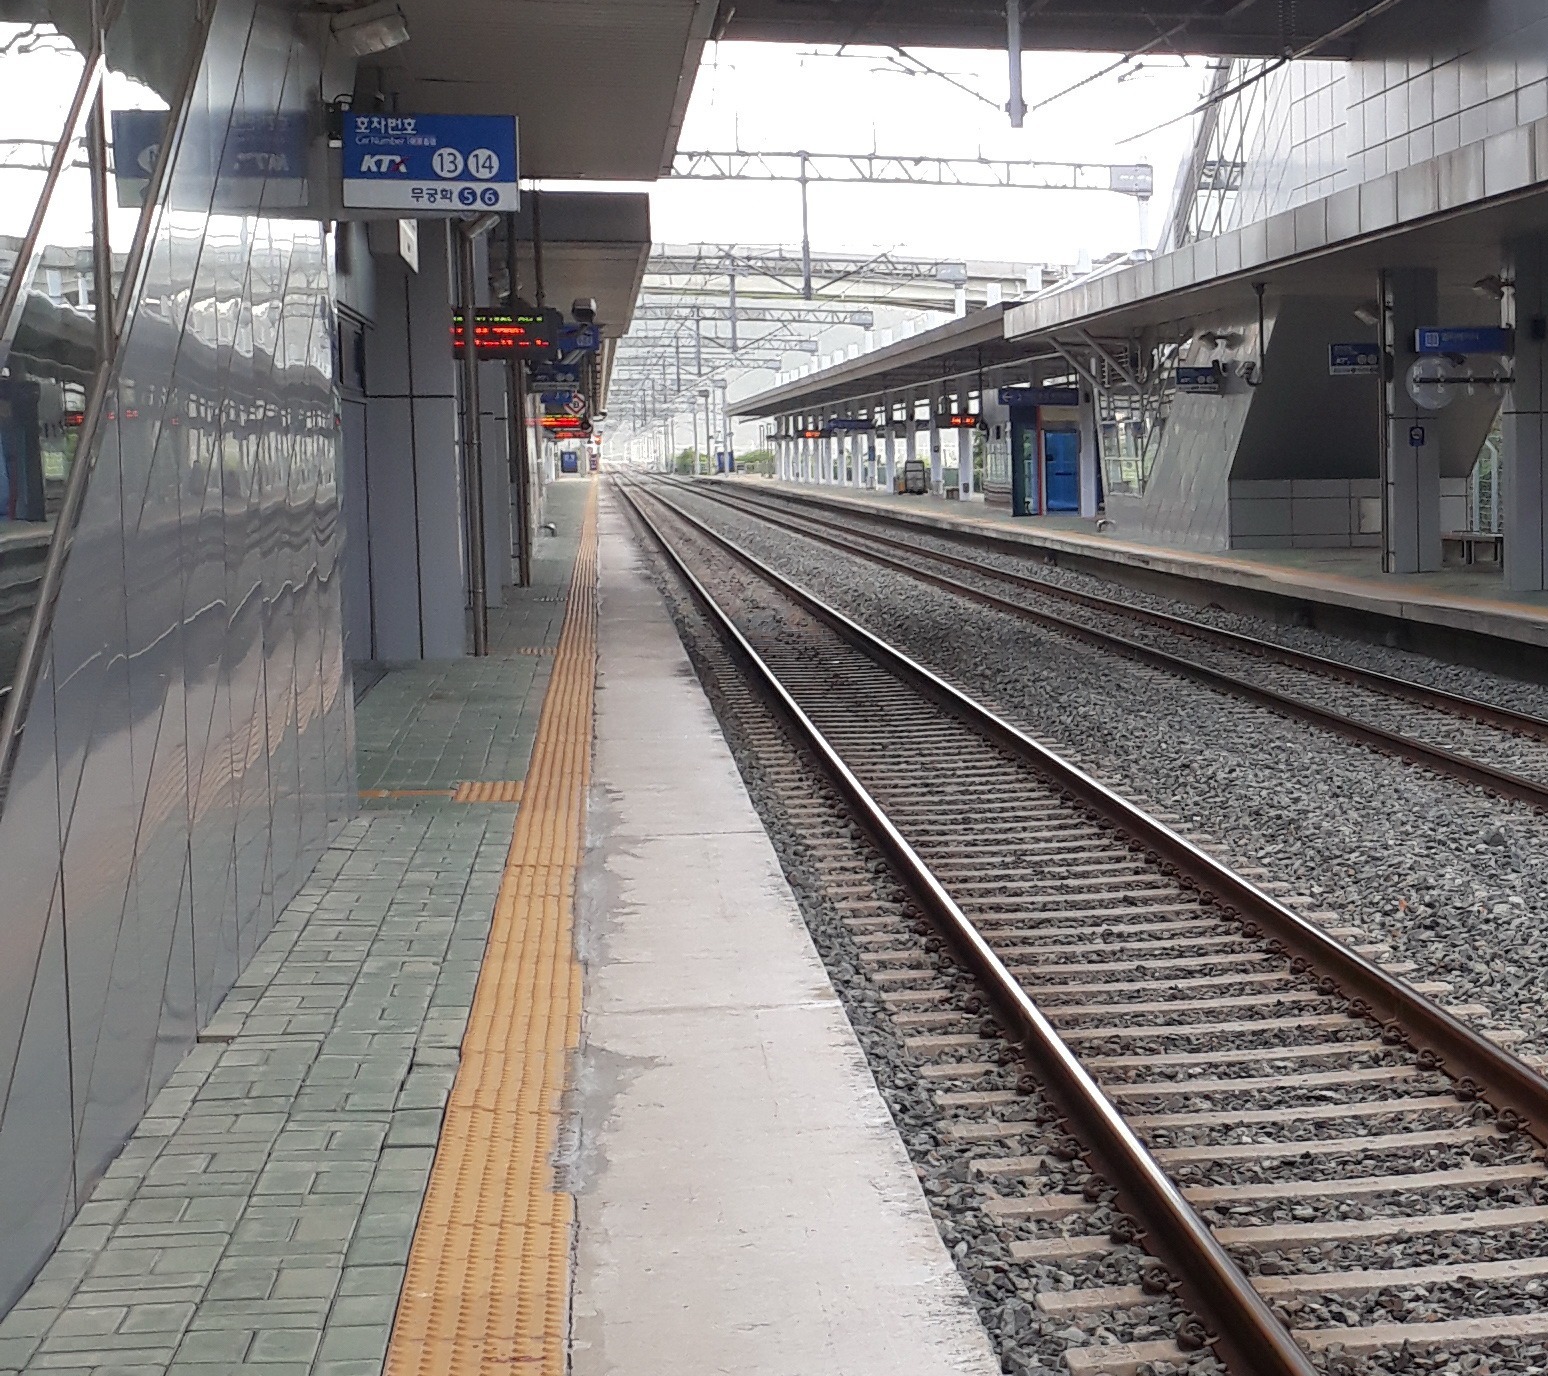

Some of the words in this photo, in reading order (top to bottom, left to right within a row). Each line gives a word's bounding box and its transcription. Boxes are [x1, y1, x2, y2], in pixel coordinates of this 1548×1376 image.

[355, 116, 418, 135] 호차번호
[360, 154, 410, 173] KTX
[436, 151, 459, 175] 13
[471, 152, 495, 176] 14
[410, 187, 454, 203] 무궁화
